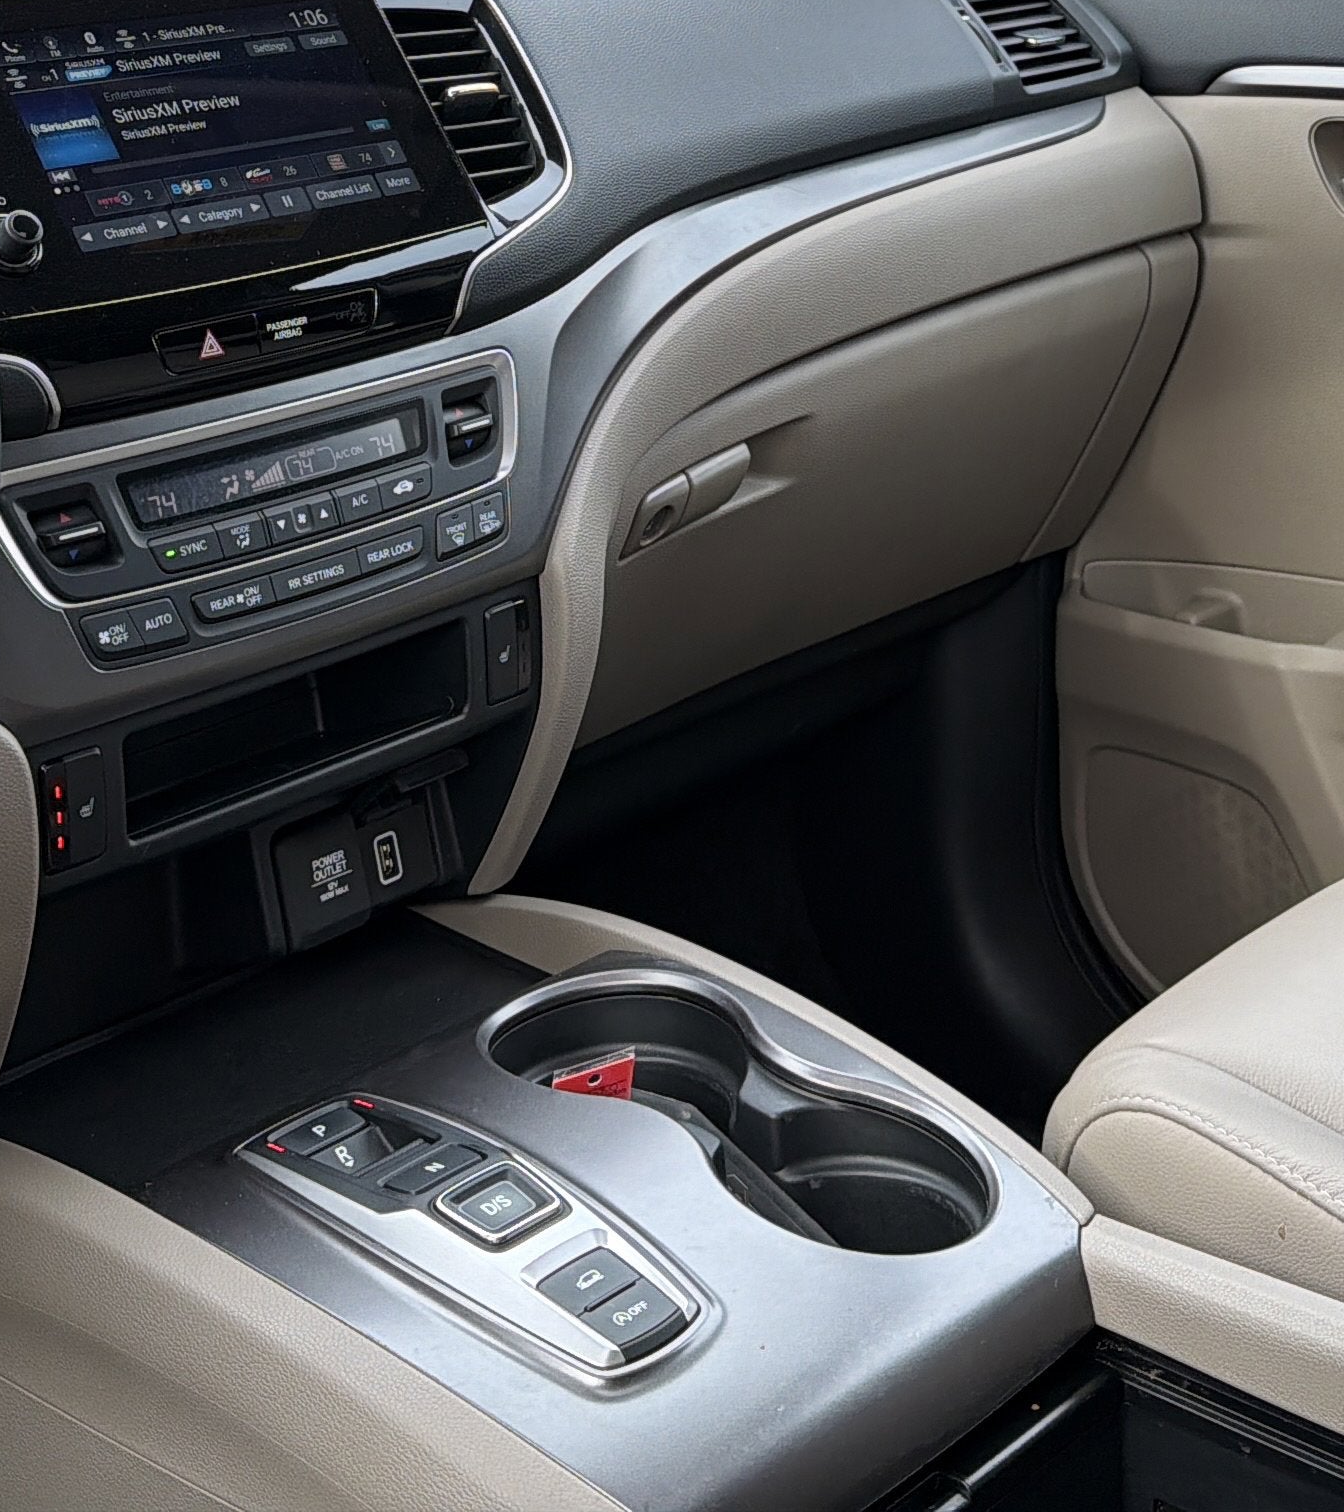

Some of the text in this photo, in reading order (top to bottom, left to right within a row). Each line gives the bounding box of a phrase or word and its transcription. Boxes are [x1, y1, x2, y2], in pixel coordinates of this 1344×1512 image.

[288, 9, 330, 30] 1:06
[142, 31, 151, 42] 1
[157, 26, 205, 41] SiriusXM
[310, 33, 338, 47] Sound
[253, 41, 289, 55] Settings
[116, 49, 222, 73] SiriusXM Preview
[103, 84, 174, 103] Entertainment
[112, 94, 241, 125] SiriusXM Preview
[120, 118, 208, 141] SiriusXM Preview
[357, 152, 373, 164] 74
[282, 165, 298, 178] 26
[219, 176, 229, 188] 8
[385, 174, 413, 190] More
[143, 189, 154, 201] 2
[315, 181, 374, 202] Channel List
[197, 204, 244, 226] Category
[103, 222, 149, 242] Channel
[266, 315, 309, 333] PASSENGER
[273, 326, 304, 342] AIRBAG
[335, 446, 365, 461] A/C ON
[368, 433, 396, 458] 74
[292, 457, 315, 476] 74
[147, 491, 179, 519] 74
[352, 493, 369, 508] A/C
[479, 510, 497, 522] REAR
[230, 524, 251, 536] MODE
[445, 521, 468, 535] FRONT
[179, 539, 208, 558] SYNC
[366, 540, 415, 564] REAR LOCK
[287, 564, 346, 590] RR SETTINGS
[209, 584, 261, 612] REAR ON/
[245, 593, 263, 607] OFF
[107, 623, 127, 636] ON/
[144, 612, 173, 631] AUTO
[111, 632, 130, 646] OFF
[311, 849, 346, 872] POWER
[313, 859, 348, 882] OUTLET
[311, 1124, 327, 1138] P
[334, 1145, 351, 1164] R
[423, 1161, 445, 1174] N
[479, 1194, 514, 1217] D/S
[628, 1299, 650, 1317] OFF
